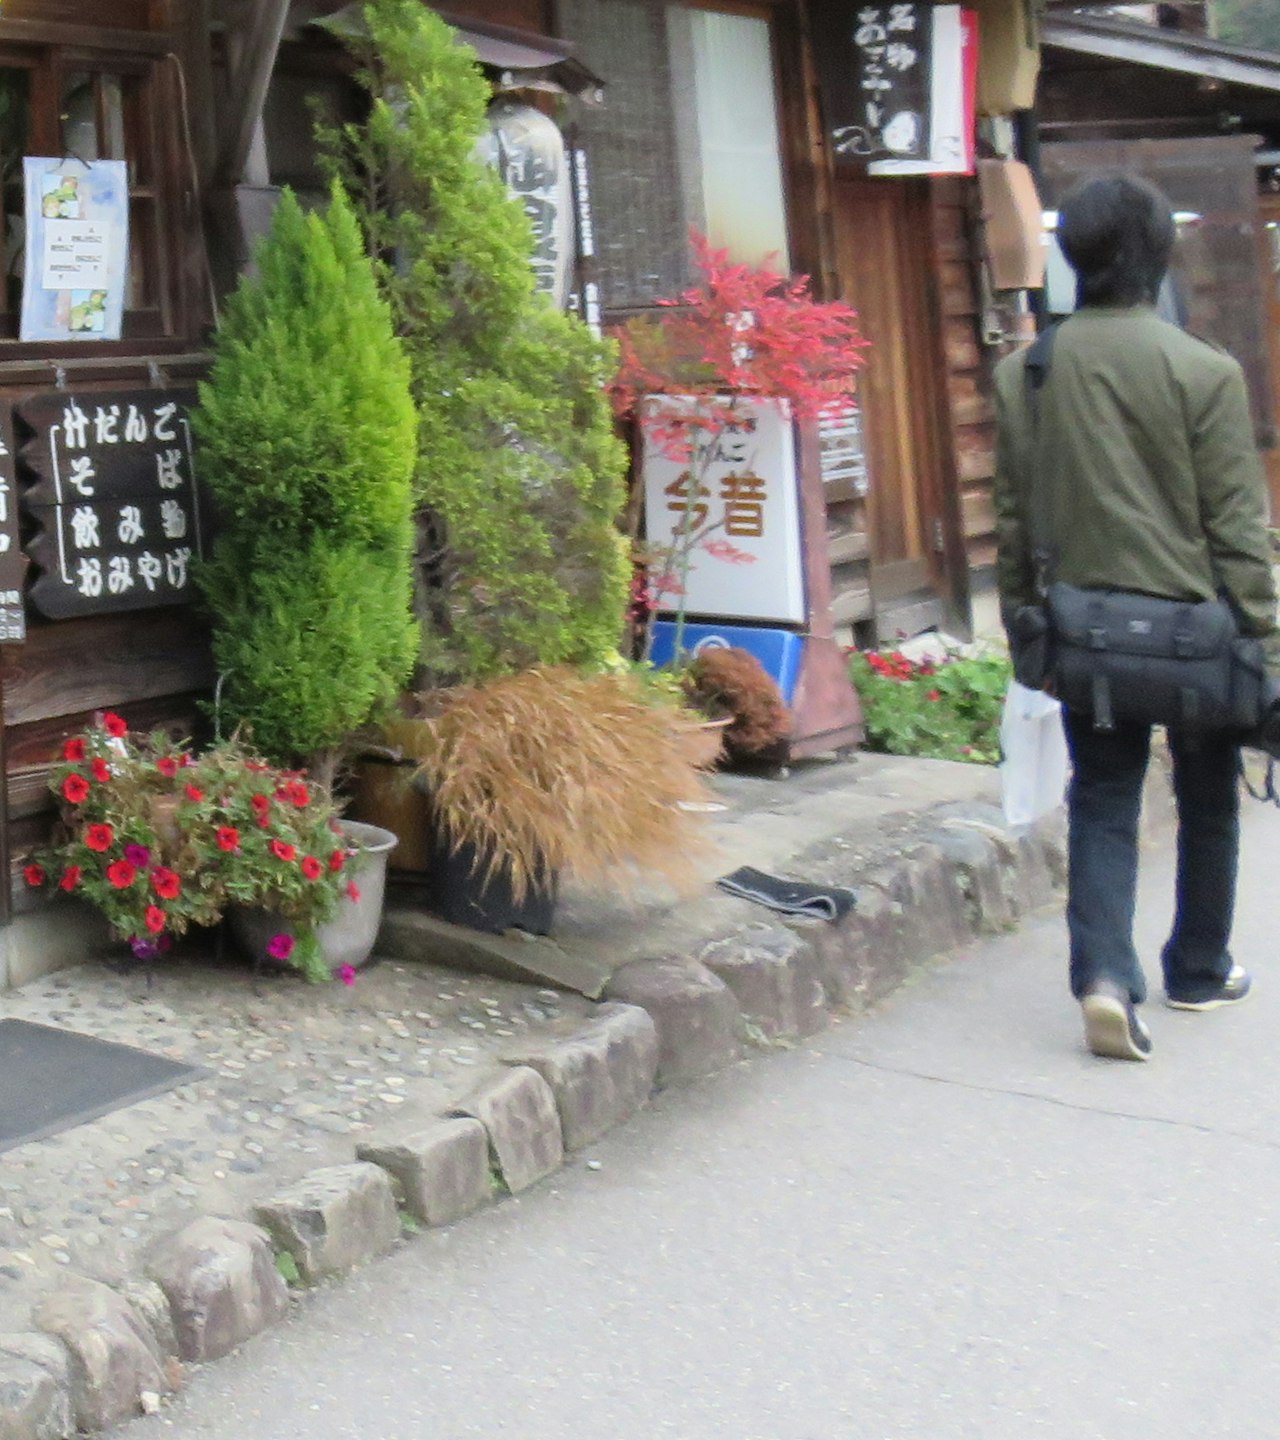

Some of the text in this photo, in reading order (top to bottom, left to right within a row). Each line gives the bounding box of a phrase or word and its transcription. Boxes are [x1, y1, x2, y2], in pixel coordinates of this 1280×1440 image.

[70, 449, 183, 496] そば
[71, 499, 187, 549] 飲み物
[664, 469, 768, 537] 今昔
[77, 547, 191, 598] おみやげ
